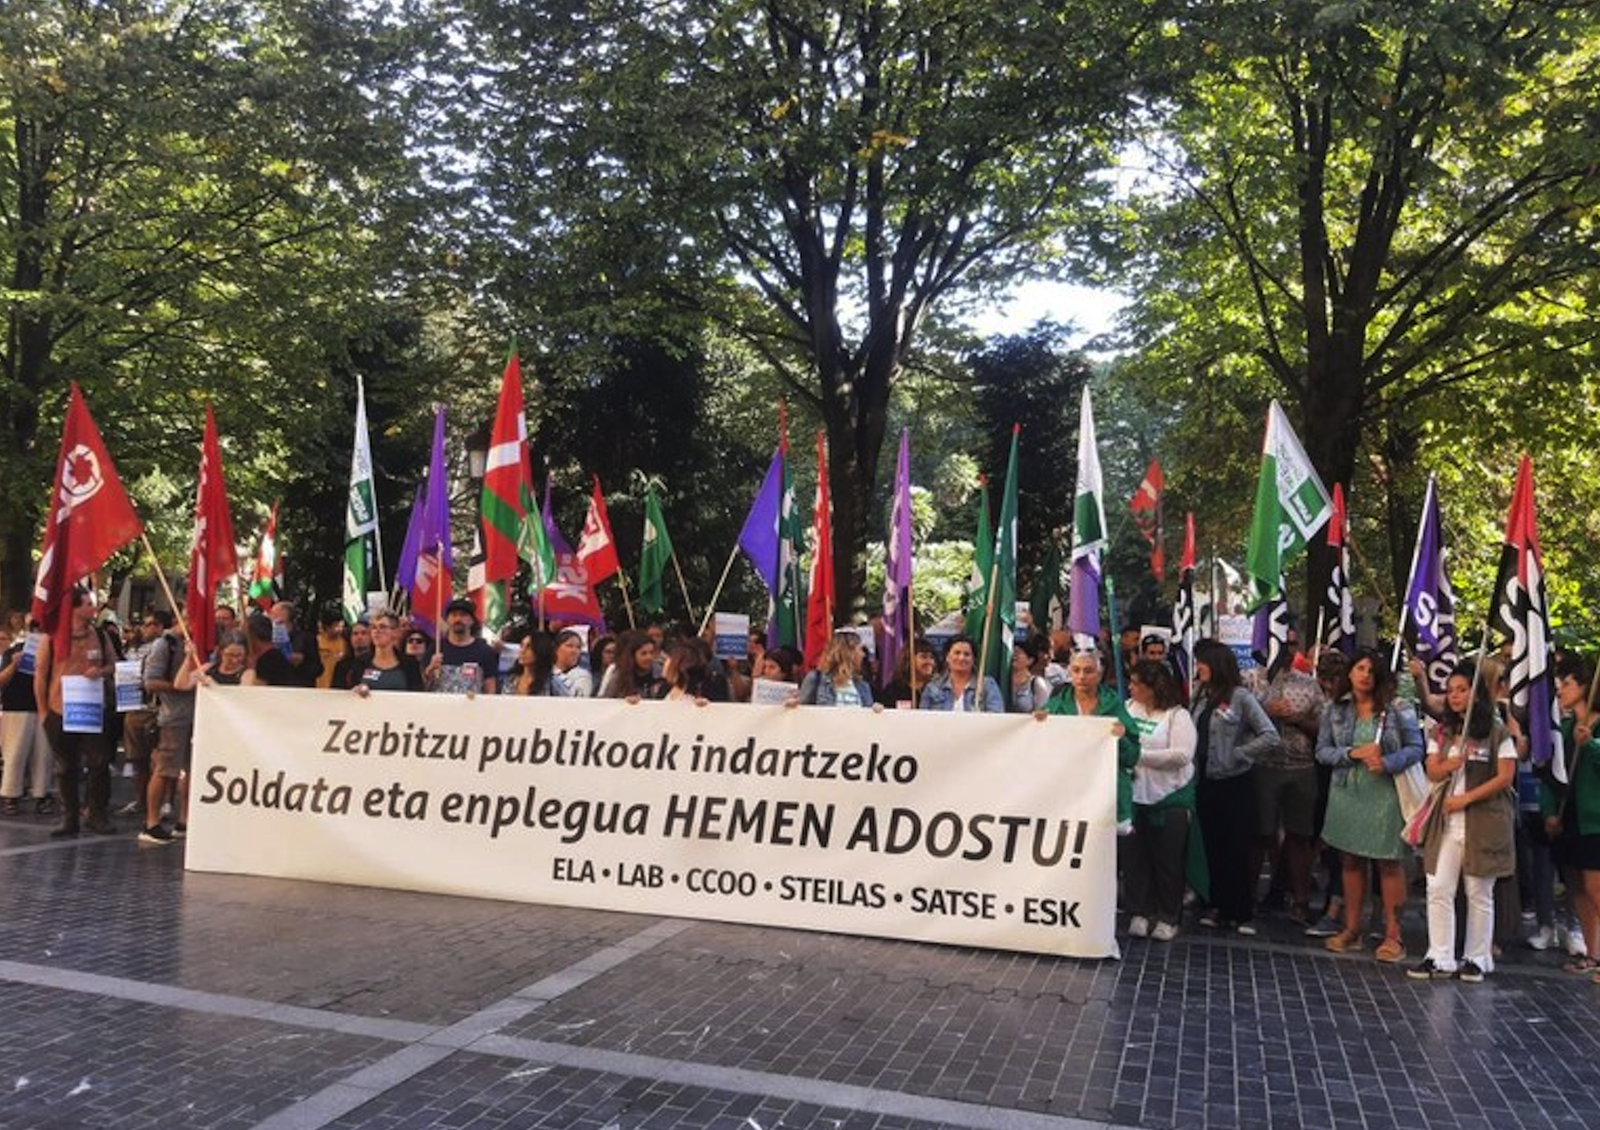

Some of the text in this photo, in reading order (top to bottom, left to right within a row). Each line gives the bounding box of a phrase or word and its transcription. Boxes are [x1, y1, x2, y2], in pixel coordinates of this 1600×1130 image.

[323, 720, 918, 784] Zerbitzu publikoak indartzeko
[201, 766, 1087, 868] Soldata eta enplegua HEMEN ADOSTU!
[552, 858, 1080, 927] ELA LAB CCOO STEILAS SATSE ESK
